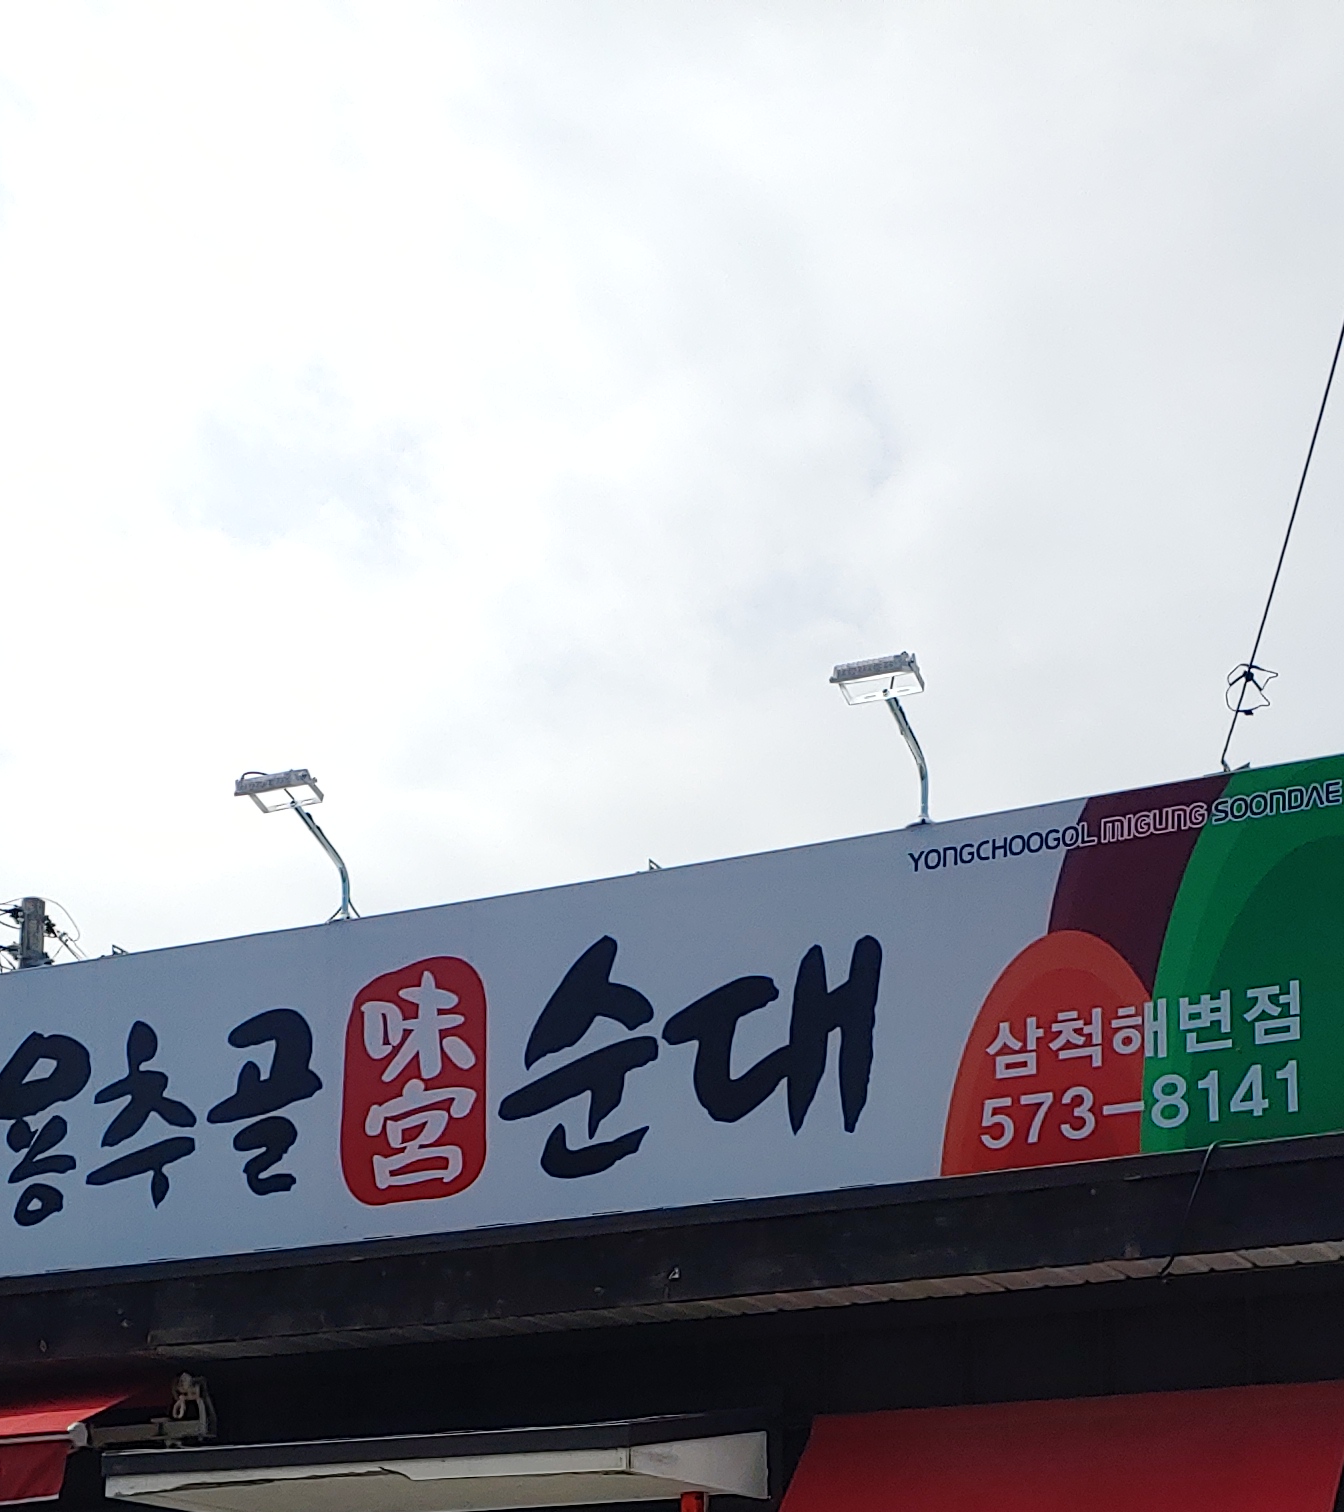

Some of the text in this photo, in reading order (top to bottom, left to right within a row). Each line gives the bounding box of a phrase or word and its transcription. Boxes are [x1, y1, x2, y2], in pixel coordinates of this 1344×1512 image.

[907, 779, 1343, 873] YONGCHOOGOL MIGUNG SOONDAE
[362, 970, 478, 1190] 味宮
[498, 934, 884, 1180] 순대
[985, 979, 1302, 1080] 삼척해변점
[979, 1059, 1301, 1151] 573-8141
